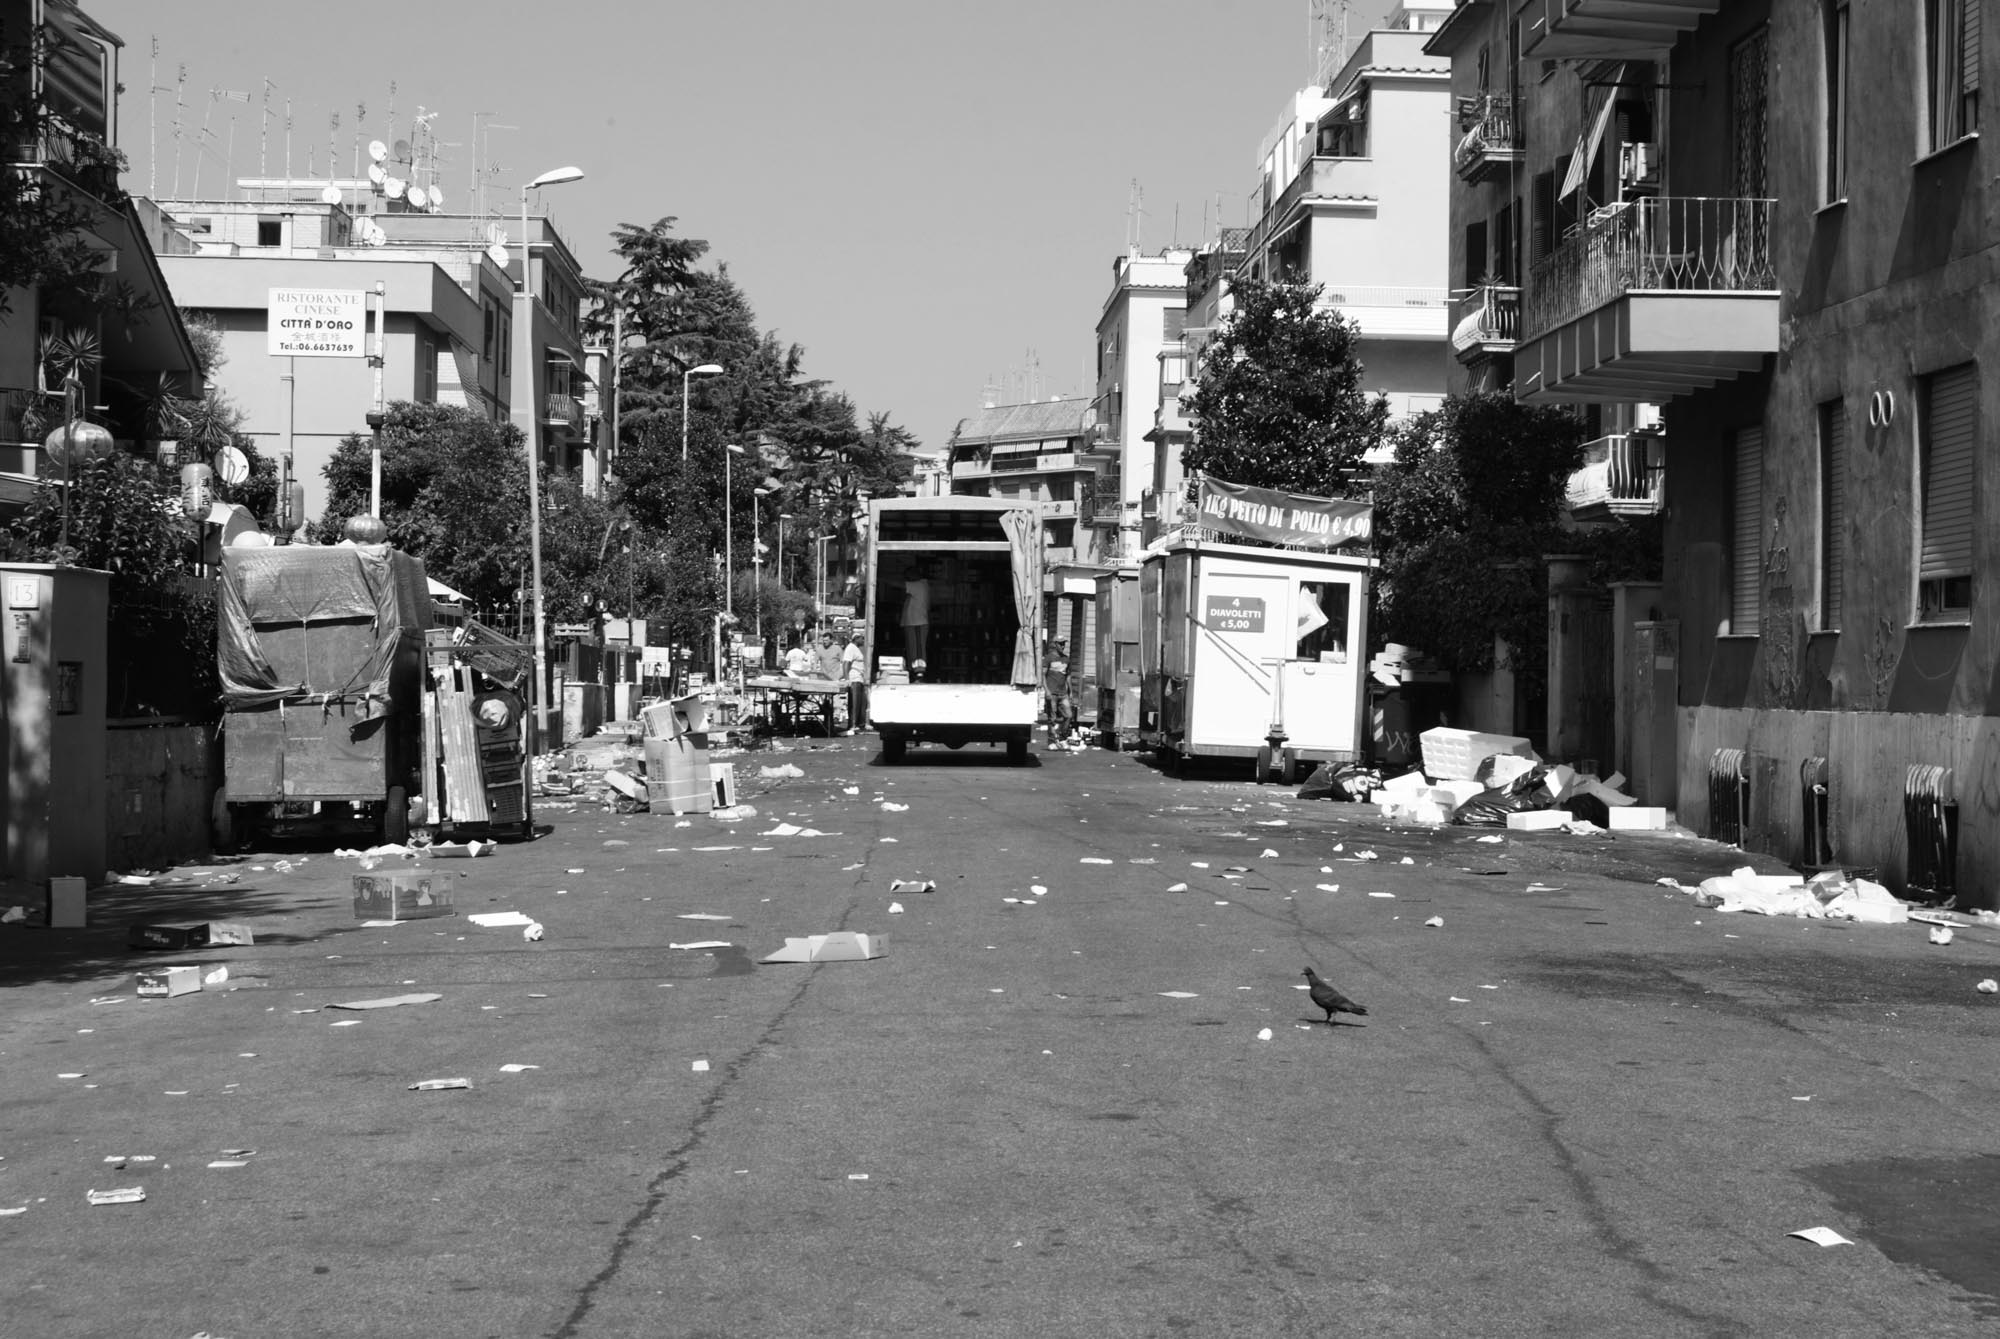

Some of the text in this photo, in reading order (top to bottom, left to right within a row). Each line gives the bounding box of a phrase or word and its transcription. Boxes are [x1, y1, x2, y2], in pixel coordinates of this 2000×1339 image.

[277, 292, 359, 305] RISTORANTE
[294, 304, 341, 315] CINESE
[315, 320, 353, 330] D'ORO
[1204, 493, 1228, 519] 1Kg
[1228, 498, 1267, 525] PETTO
[1268, 505, 1285, 528] DI
[1289, 508, 1330, 535] POLLO
[1332, 516, 1342, 536] €
[15, 584, 33, 602] 13
[1232, 598, 1240, 607] 4
[1210, 608, 1261, 618] DIAVOLETTI
[1228, 619, 1250, 629] 5,00
